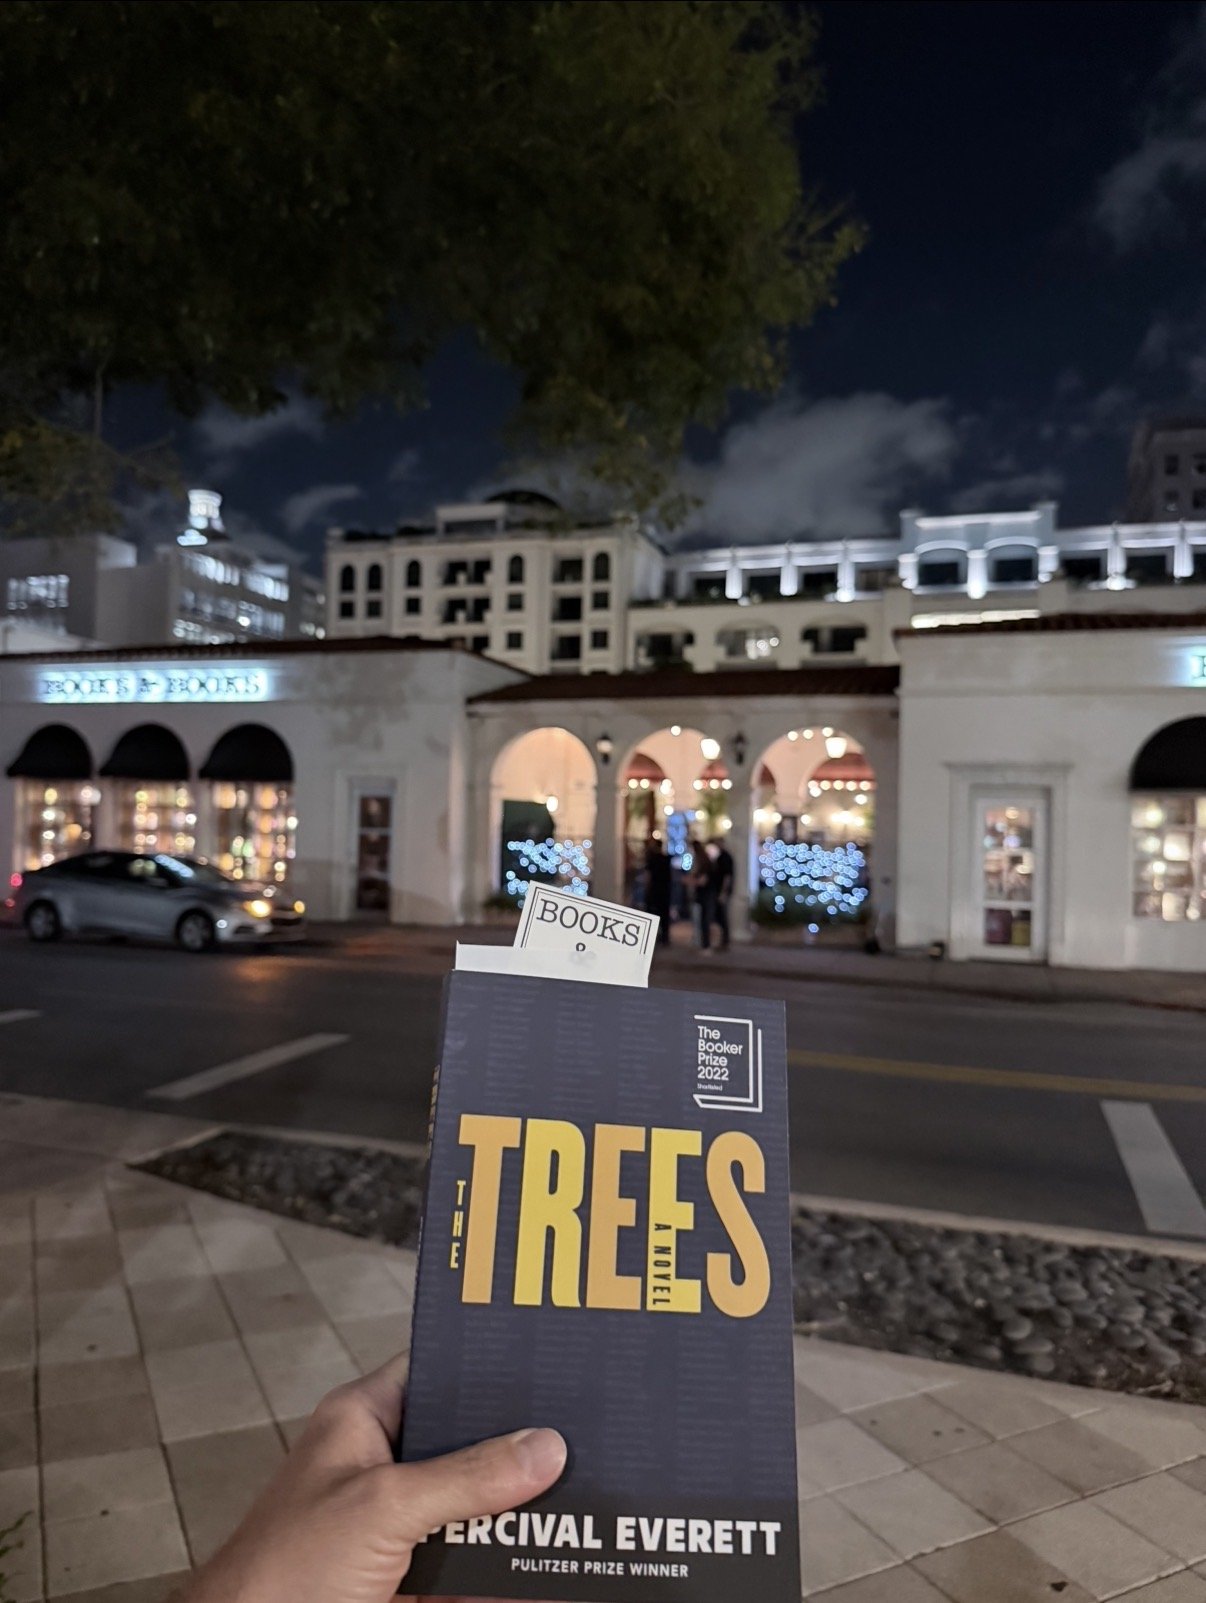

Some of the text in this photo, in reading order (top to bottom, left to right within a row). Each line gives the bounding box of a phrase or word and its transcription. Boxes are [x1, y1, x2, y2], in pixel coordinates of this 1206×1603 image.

[536, 898, 641, 947] BOOKS
[697, 1025, 721, 1040] The
[698, 1039, 744, 1056] Booker
[697, 1066, 729, 1081] 2022
[698, 1052, 728, 1067] Prize
[450, 1180, 466, 1269] THE
[458, 1113, 771, 1318] TREES
[652, 1223, 672, 1305] A NOVEL
[615, 1516, 782, 1556] EVERETT
[511, 1558, 689, 1578] PULITZER PRIZE WINNER
